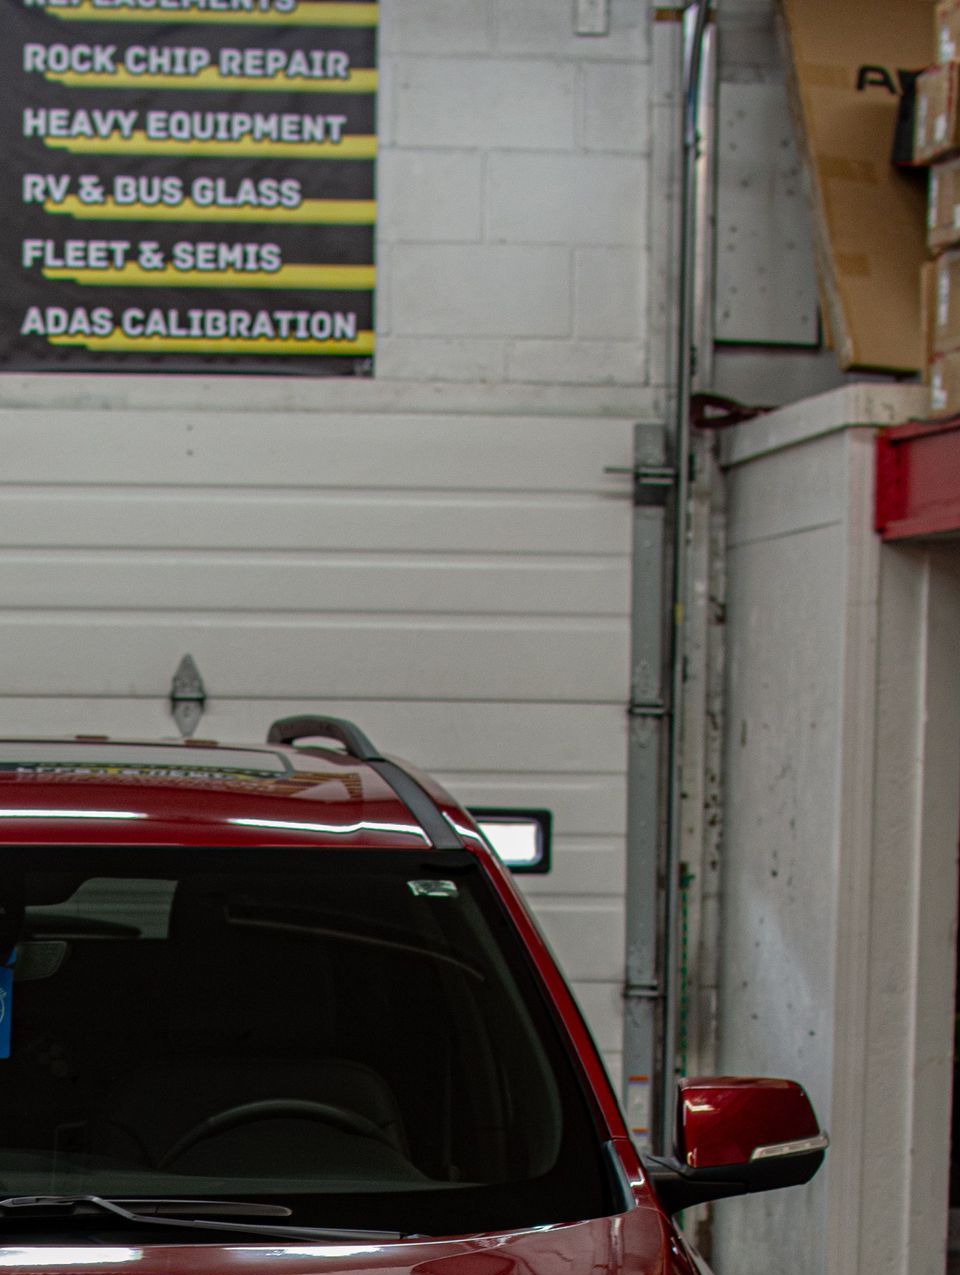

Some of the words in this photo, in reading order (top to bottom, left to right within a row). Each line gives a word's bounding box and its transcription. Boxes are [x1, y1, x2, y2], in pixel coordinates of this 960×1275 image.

[24, 44, 117, 73] ROCK
[125, 45, 211, 75] CHIP
[220, 48, 350, 77] REPAIR
[23, 108, 138, 137] HEAVY
[147, 111, 347, 142] EQUIPMENT
[23, 174, 70, 202] RV
[79, 176, 104, 203] &
[114, 176, 183, 205] BUS
[192, 178, 302, 207] GLASS
[23, 239, 130, 268] FLEET
[139, 242, 165, 269] &
[173, 243, 282, 271] SEMIS
[21, 307, 113, 336] ADAS
[122, 309, 357, 339] CALIBRATION
